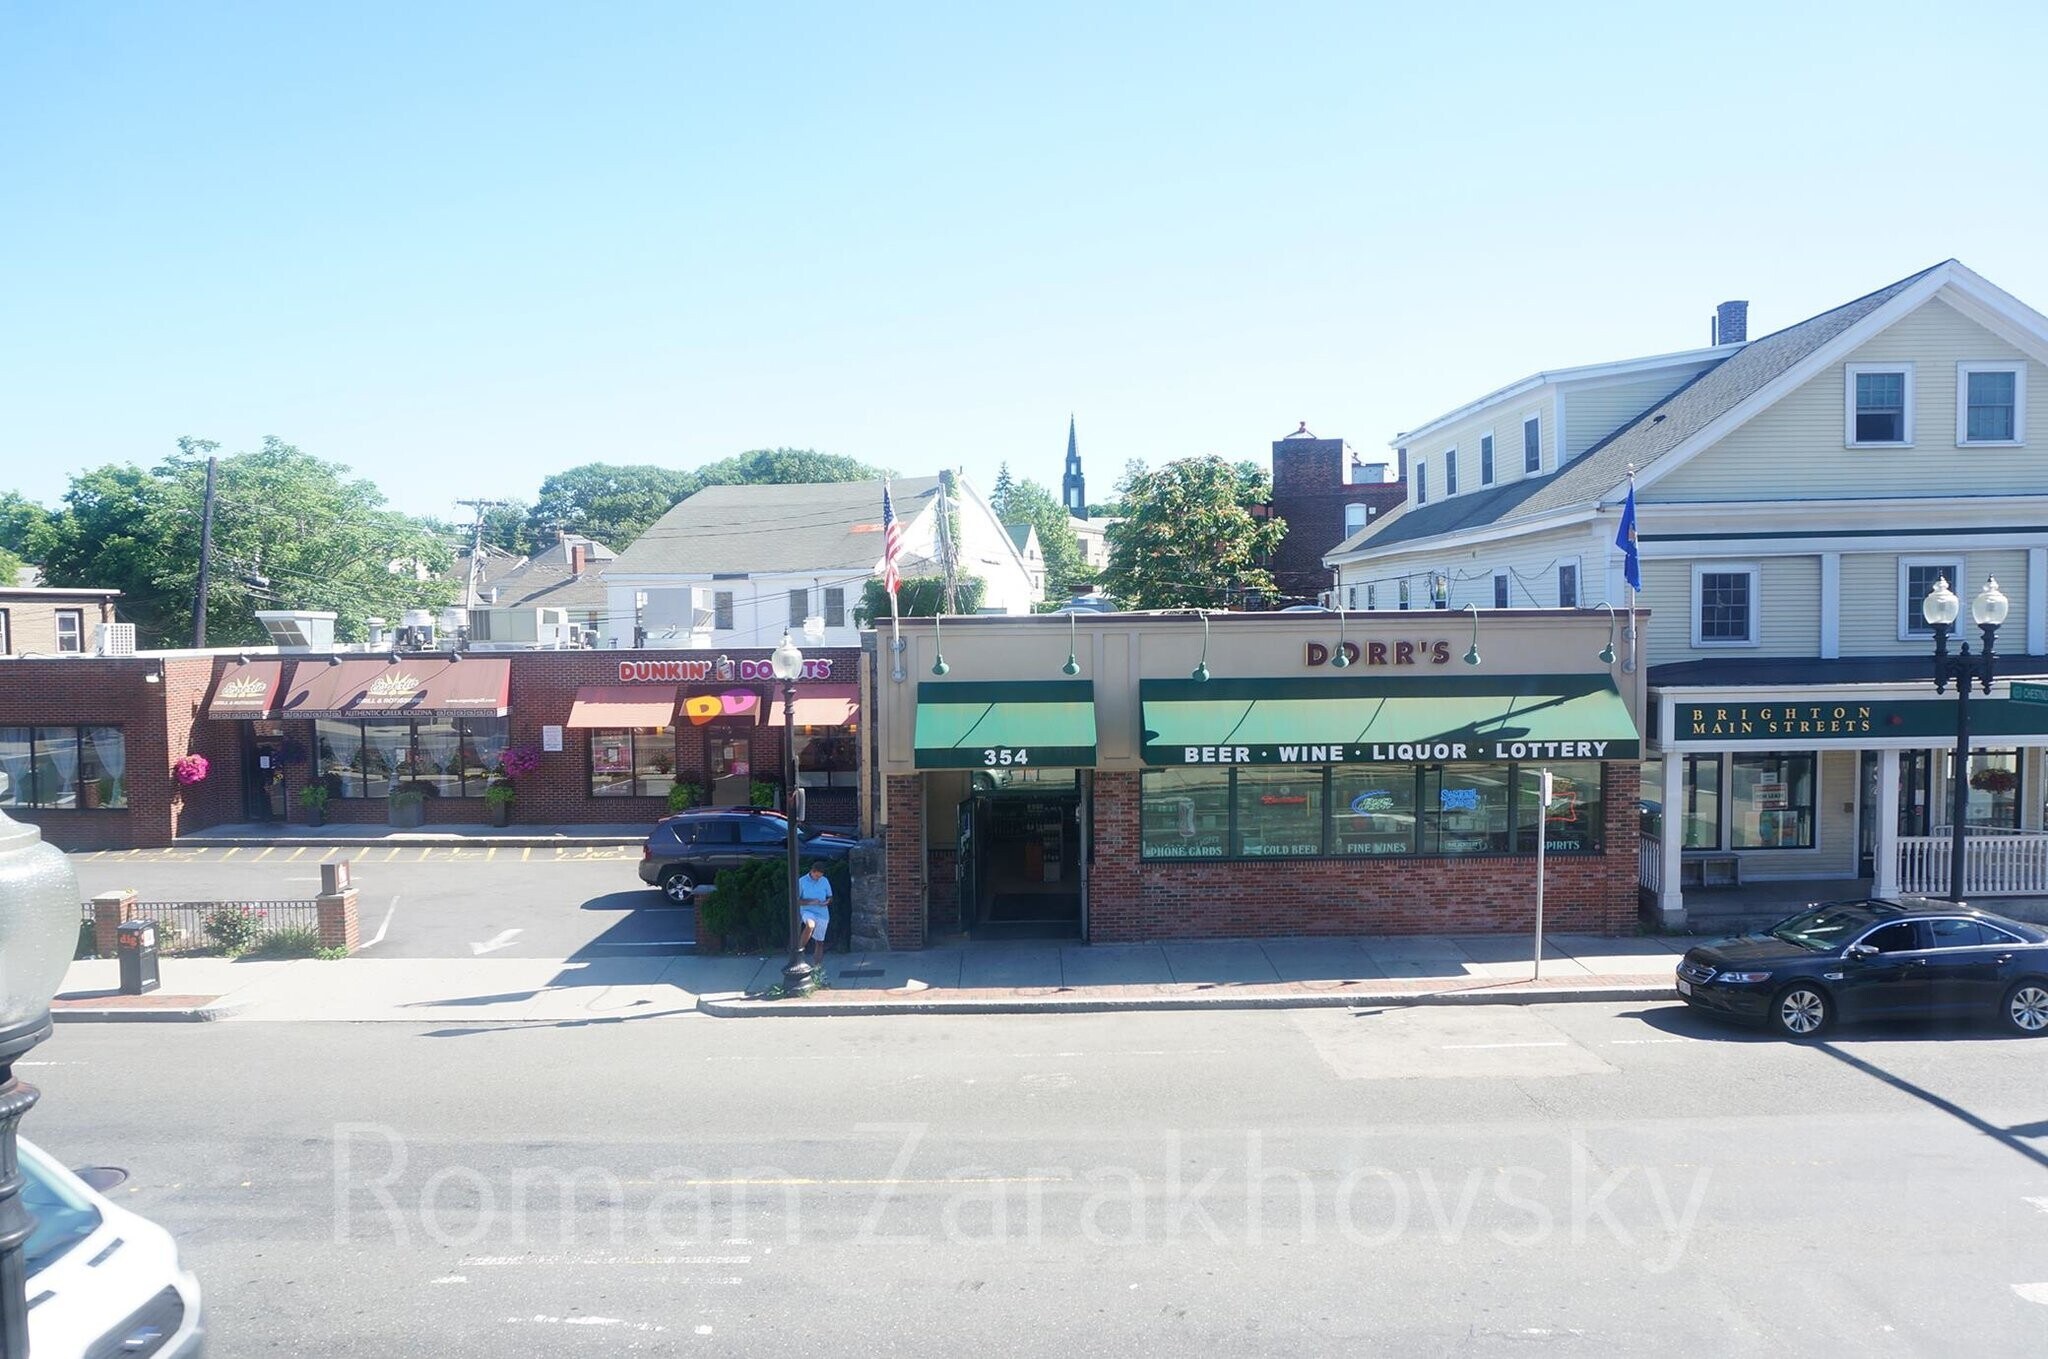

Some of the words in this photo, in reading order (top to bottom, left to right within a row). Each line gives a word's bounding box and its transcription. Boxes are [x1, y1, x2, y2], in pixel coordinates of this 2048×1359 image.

[1305, 641, 1450, 666] DORR'S
[620, 661, 712, 681] DUNKIN'
[741, 659, 831, 680] DOTS
[1693, 707, 1870, 721] BRIGHTON
[1693, 722, 1752, 734] MAIN
[1769, 720, 1870, 733] STREETS
[984, 749, 1028, 765] 354
[1184, 747, 1250, 762] BEER
[1279, 745, 1343, 762] WINE
[1372, 743, 1467, 761] LIQUOR
[1496, 741, 1609, 758] LOTTERY
[1151, 846, 1185, 857] PHONE
[1188, 846, 1223, 856] CARDS
[1263, 845, 1289, 855] COLD
[1292, 845, 1318, 855] BEER
[1347, 843, 1371, 853] FINE
